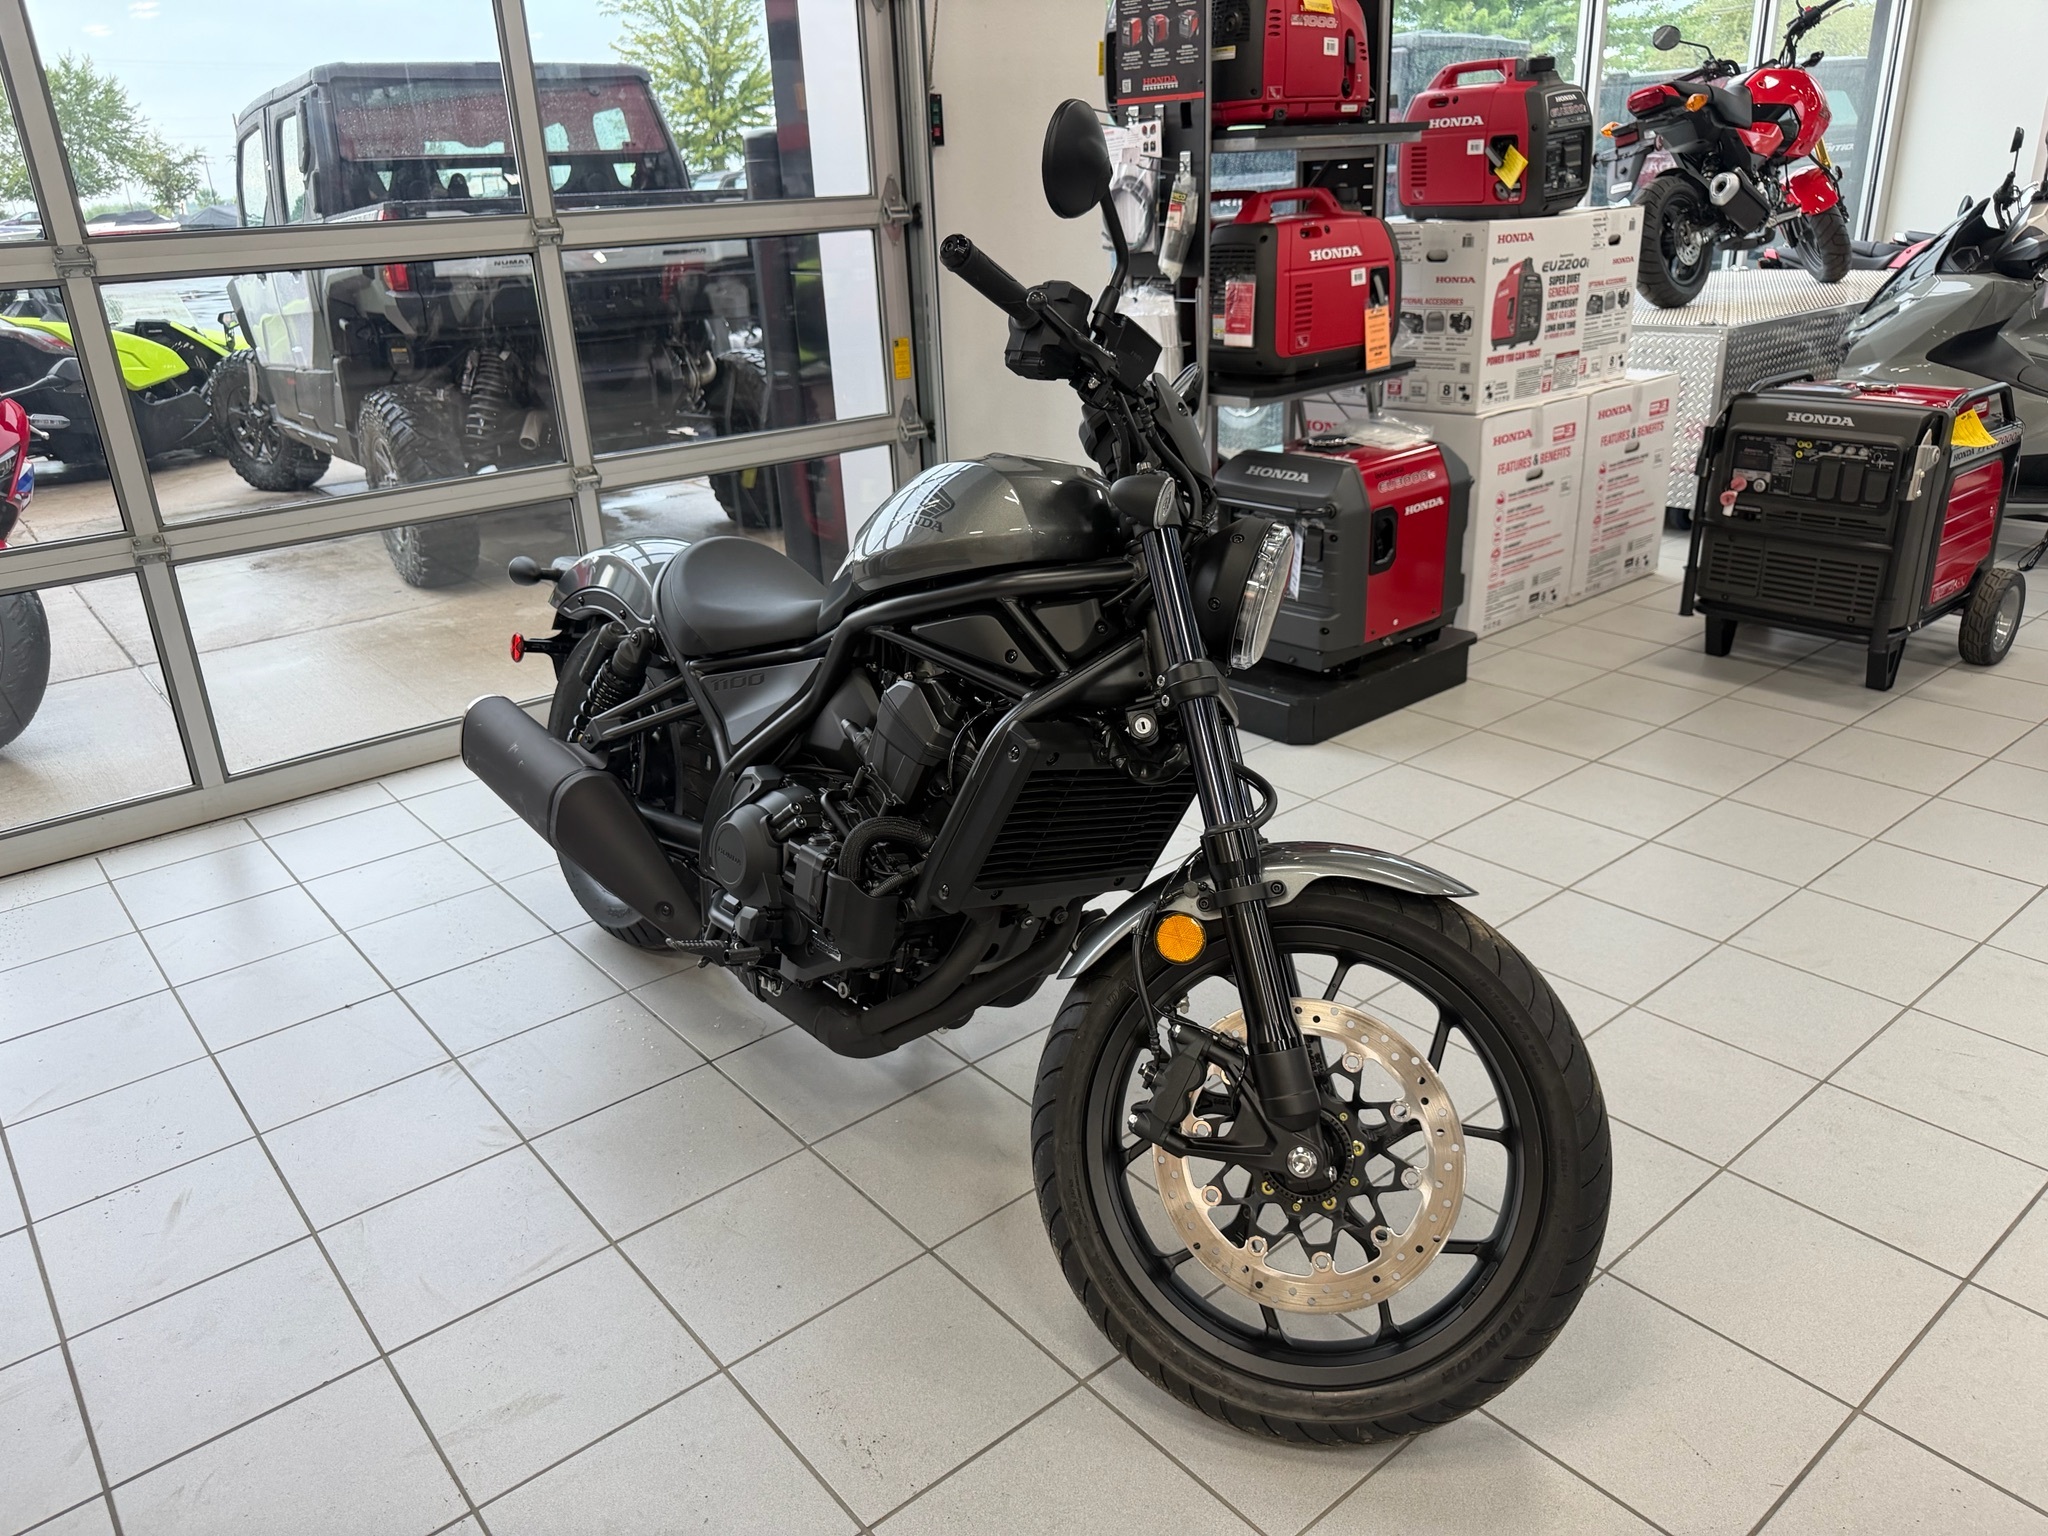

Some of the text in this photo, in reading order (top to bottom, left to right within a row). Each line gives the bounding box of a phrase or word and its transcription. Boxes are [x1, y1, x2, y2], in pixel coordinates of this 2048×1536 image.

[1143, 75, 1177, 85] HONDA
[1555, 94, 1577, 102] HONDA
[1429, 115, 1484, 129] HONDA
[1497, 232, 1535, 244] HONDA
[1309, 245, 1363, 262] HONDA
[1612, 256, 1634, 265] HONDA
[1542, 257, 1589, 272] EU2200i
[1435, 276, 1475, 284] HONDA
[1443, 384, 1450, 396] 8
[1598, 404, 1632, 419] HONDA
[1786, 412, 1855, 427] HONDA
[1493, 429, 1533, 446] HONDA
[1601, 420, 1665, 447] FEATURES & BENEFITS
[1497, 446, 1571, 476] FEATURES & BENEFITS
[1953, 448, 1975, 462] HONDA
[1245, 465, 1310, 483] HONDA
[1404, 495, 1445, 516] HONDA
[711, 673, 765, 691] 1100
[1441, 1303, 1525, 1385] DUNLOP
